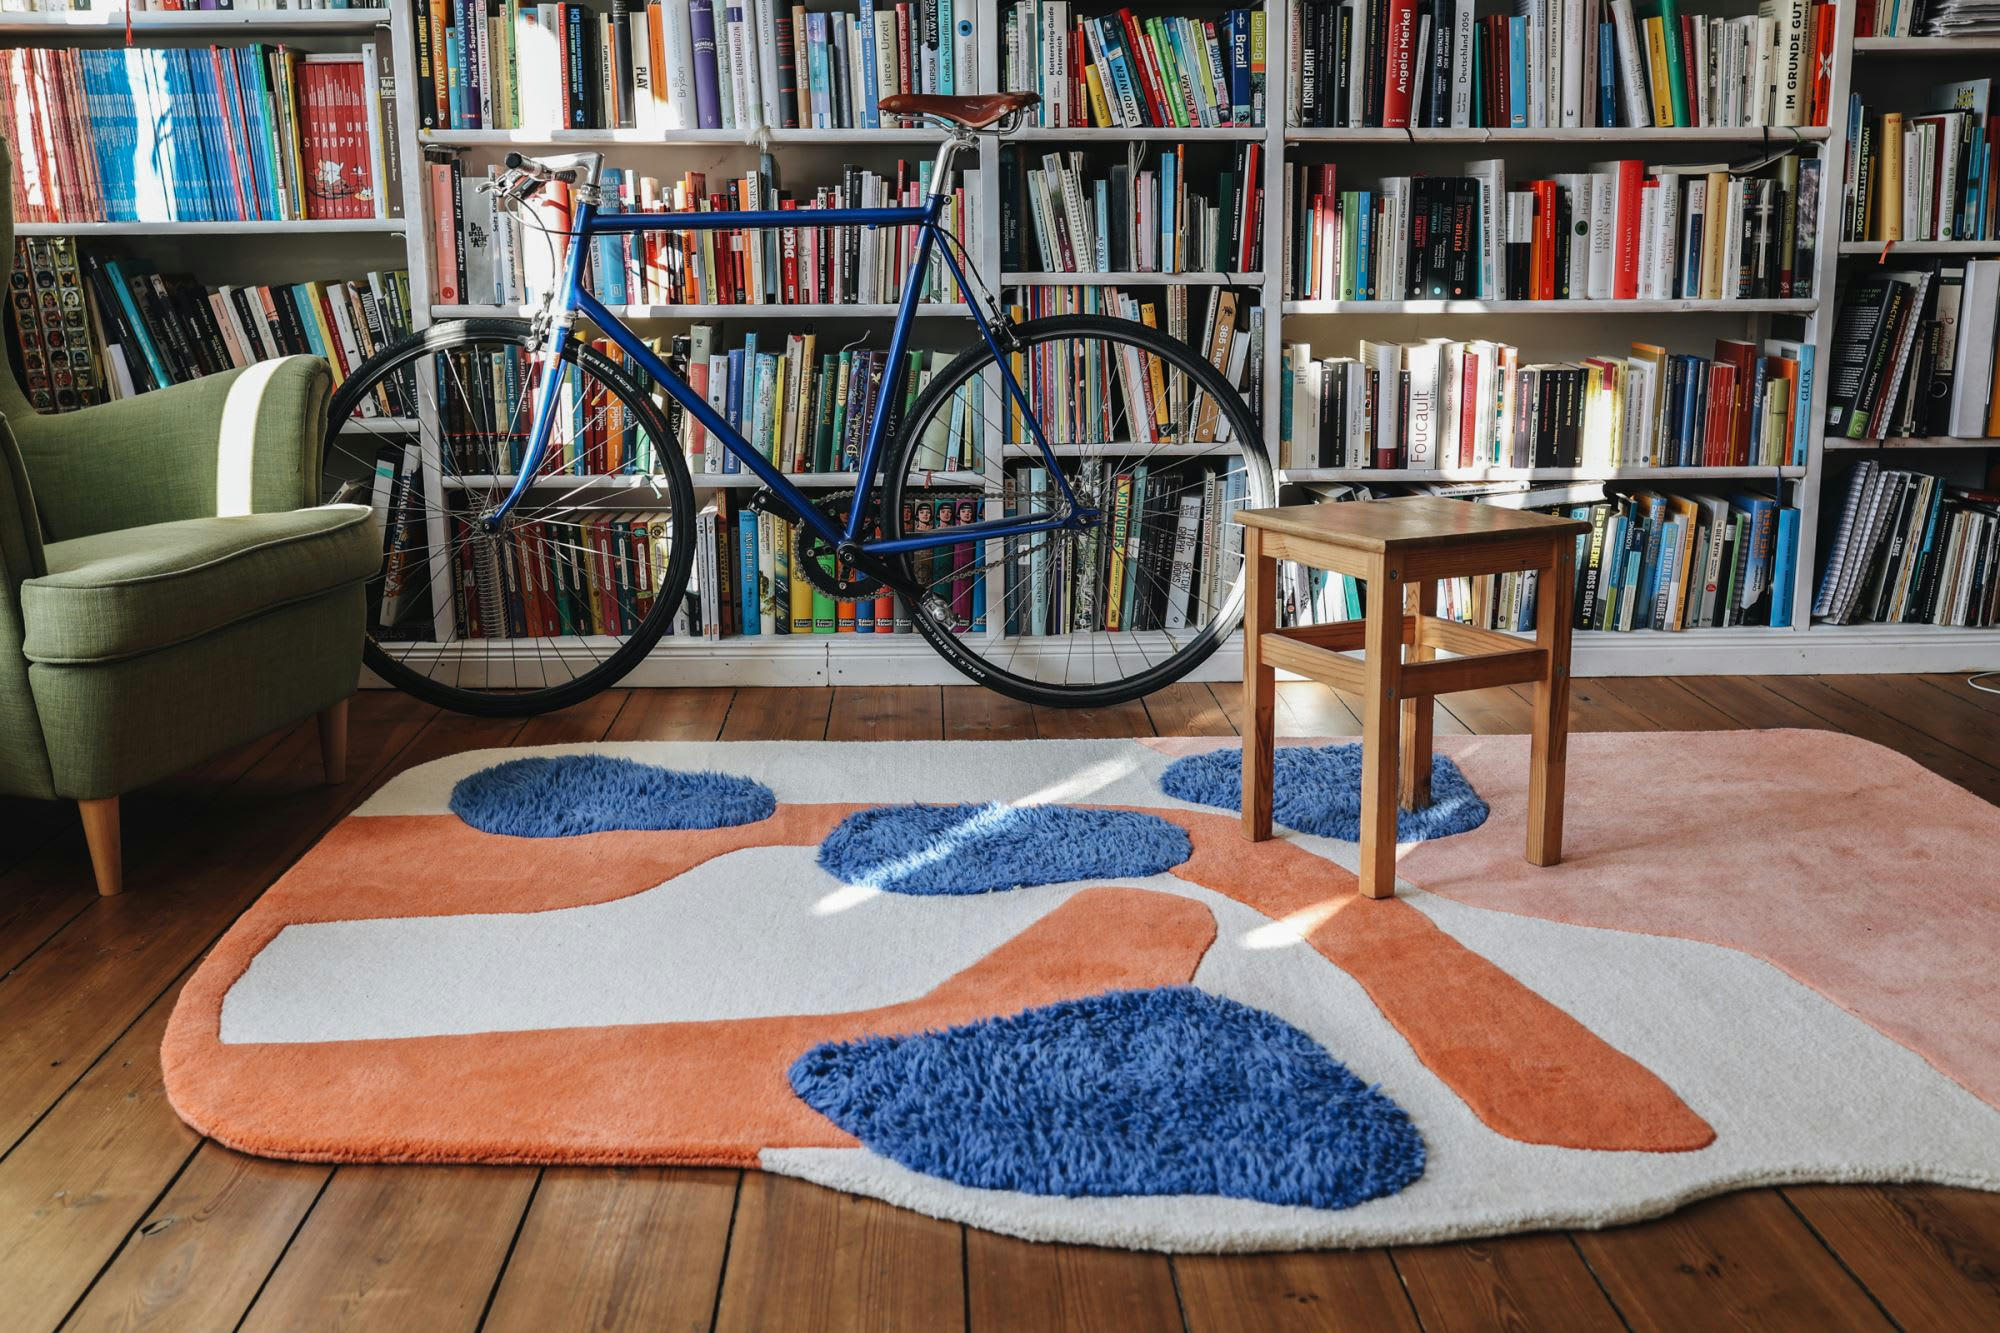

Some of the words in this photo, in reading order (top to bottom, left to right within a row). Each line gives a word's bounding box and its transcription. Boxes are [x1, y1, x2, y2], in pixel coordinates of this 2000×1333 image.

[456, 2, 466, 57] KAKALIOS
[571, 8, 580, 22] ICH
[1400, 8, 1411, 50] Merkel
[1462, 12, 1470, 33] 2050
[1792, 2, 1802, 31] GUT
[881, 20, 890, 50] Urzeit
[943, 17, 951, 56] Naturführer
[1254, 14, 1262, 60] Brasilien
[734, 26, 742, 76] GENDERMEDIZIN
[1210, 44, 1222, 80] Ecuador
[1236, 34, 1247, 68] Brazil
[1304, 48, 1315, 76] EARTH
[1459, 35, 1468, 84] Deutschland
[1787, 34, 1800, 90] GRUNDE
[436, 60, 446, 98] BATMAN
[460, 60, 468, 87] JAMES
[636, 66, 648, 90] PLAY
[678, 66, 686, 98] Bryson
[883, 64, 892, 87] Tiere
[944, 58, 952, 82] Großer
[1396, 52, 1408, 94] Angela
[1114, 65, 1138, 122] SARDINIEN
[1180, 74, 1196, 106] PALMA
[1304, 77, 1314, 108] LOSING
[1786, 95, 1796, 110] IM
[312, 122, 338, 132] TIM
[1188, 107, 1198, 121] LA
[304, 136, 362, 148] STRUPPI
[1862, 130, 1870, 168] WORLD'S
[1603, 182, 1611, 214] Harari
[1860, 169, 1868, 204] FITTEST
[1454, 204, 1464, 251] FUTURZWEI
[1856, 204, 1866, 232] BOOK
[1594, 218, 1603, 254] HOMO
[361, 293, 380, 333] LOGICOMIX
[1889, 295, 1902, 330] PRACTICE
[1220, 325, 1229, 344] 365
[584, 352, 599, 366] TWIN
[599, 363, 614, 376] RAIL
[1213, 348, 1225, 370] Tage
[1877, 339, 1889, 366] NATURAL
[1801, 370, 1811, 400] GLÜCK
[1863, 371, 1878, 410] MOVEMENT
[1410, 390, 1429, 463] Foucault
[1206, 479, 1214, 514] MUSIKER
[1114, 491, 1128, 547] SIEBDRUCK
[1178, 527, 1186, 554] GRAPHY
[1589, 528, 1603, 568] RESILIENCE
[1626, 522, 1634, 550] FLOSSING
[1712, 542, 1720, 557] MYTH
[1172, 561, 1180, 583] BOOKS
[1664, 547, 1673, 574] NATURAL
[1587, 570, 1596, 589] ROSS
[1661, 575, 1670, 591] BORN
[1582, 590, 1594, 618] EDGLEY
[1656, 591, 1667, 620] HEROES
